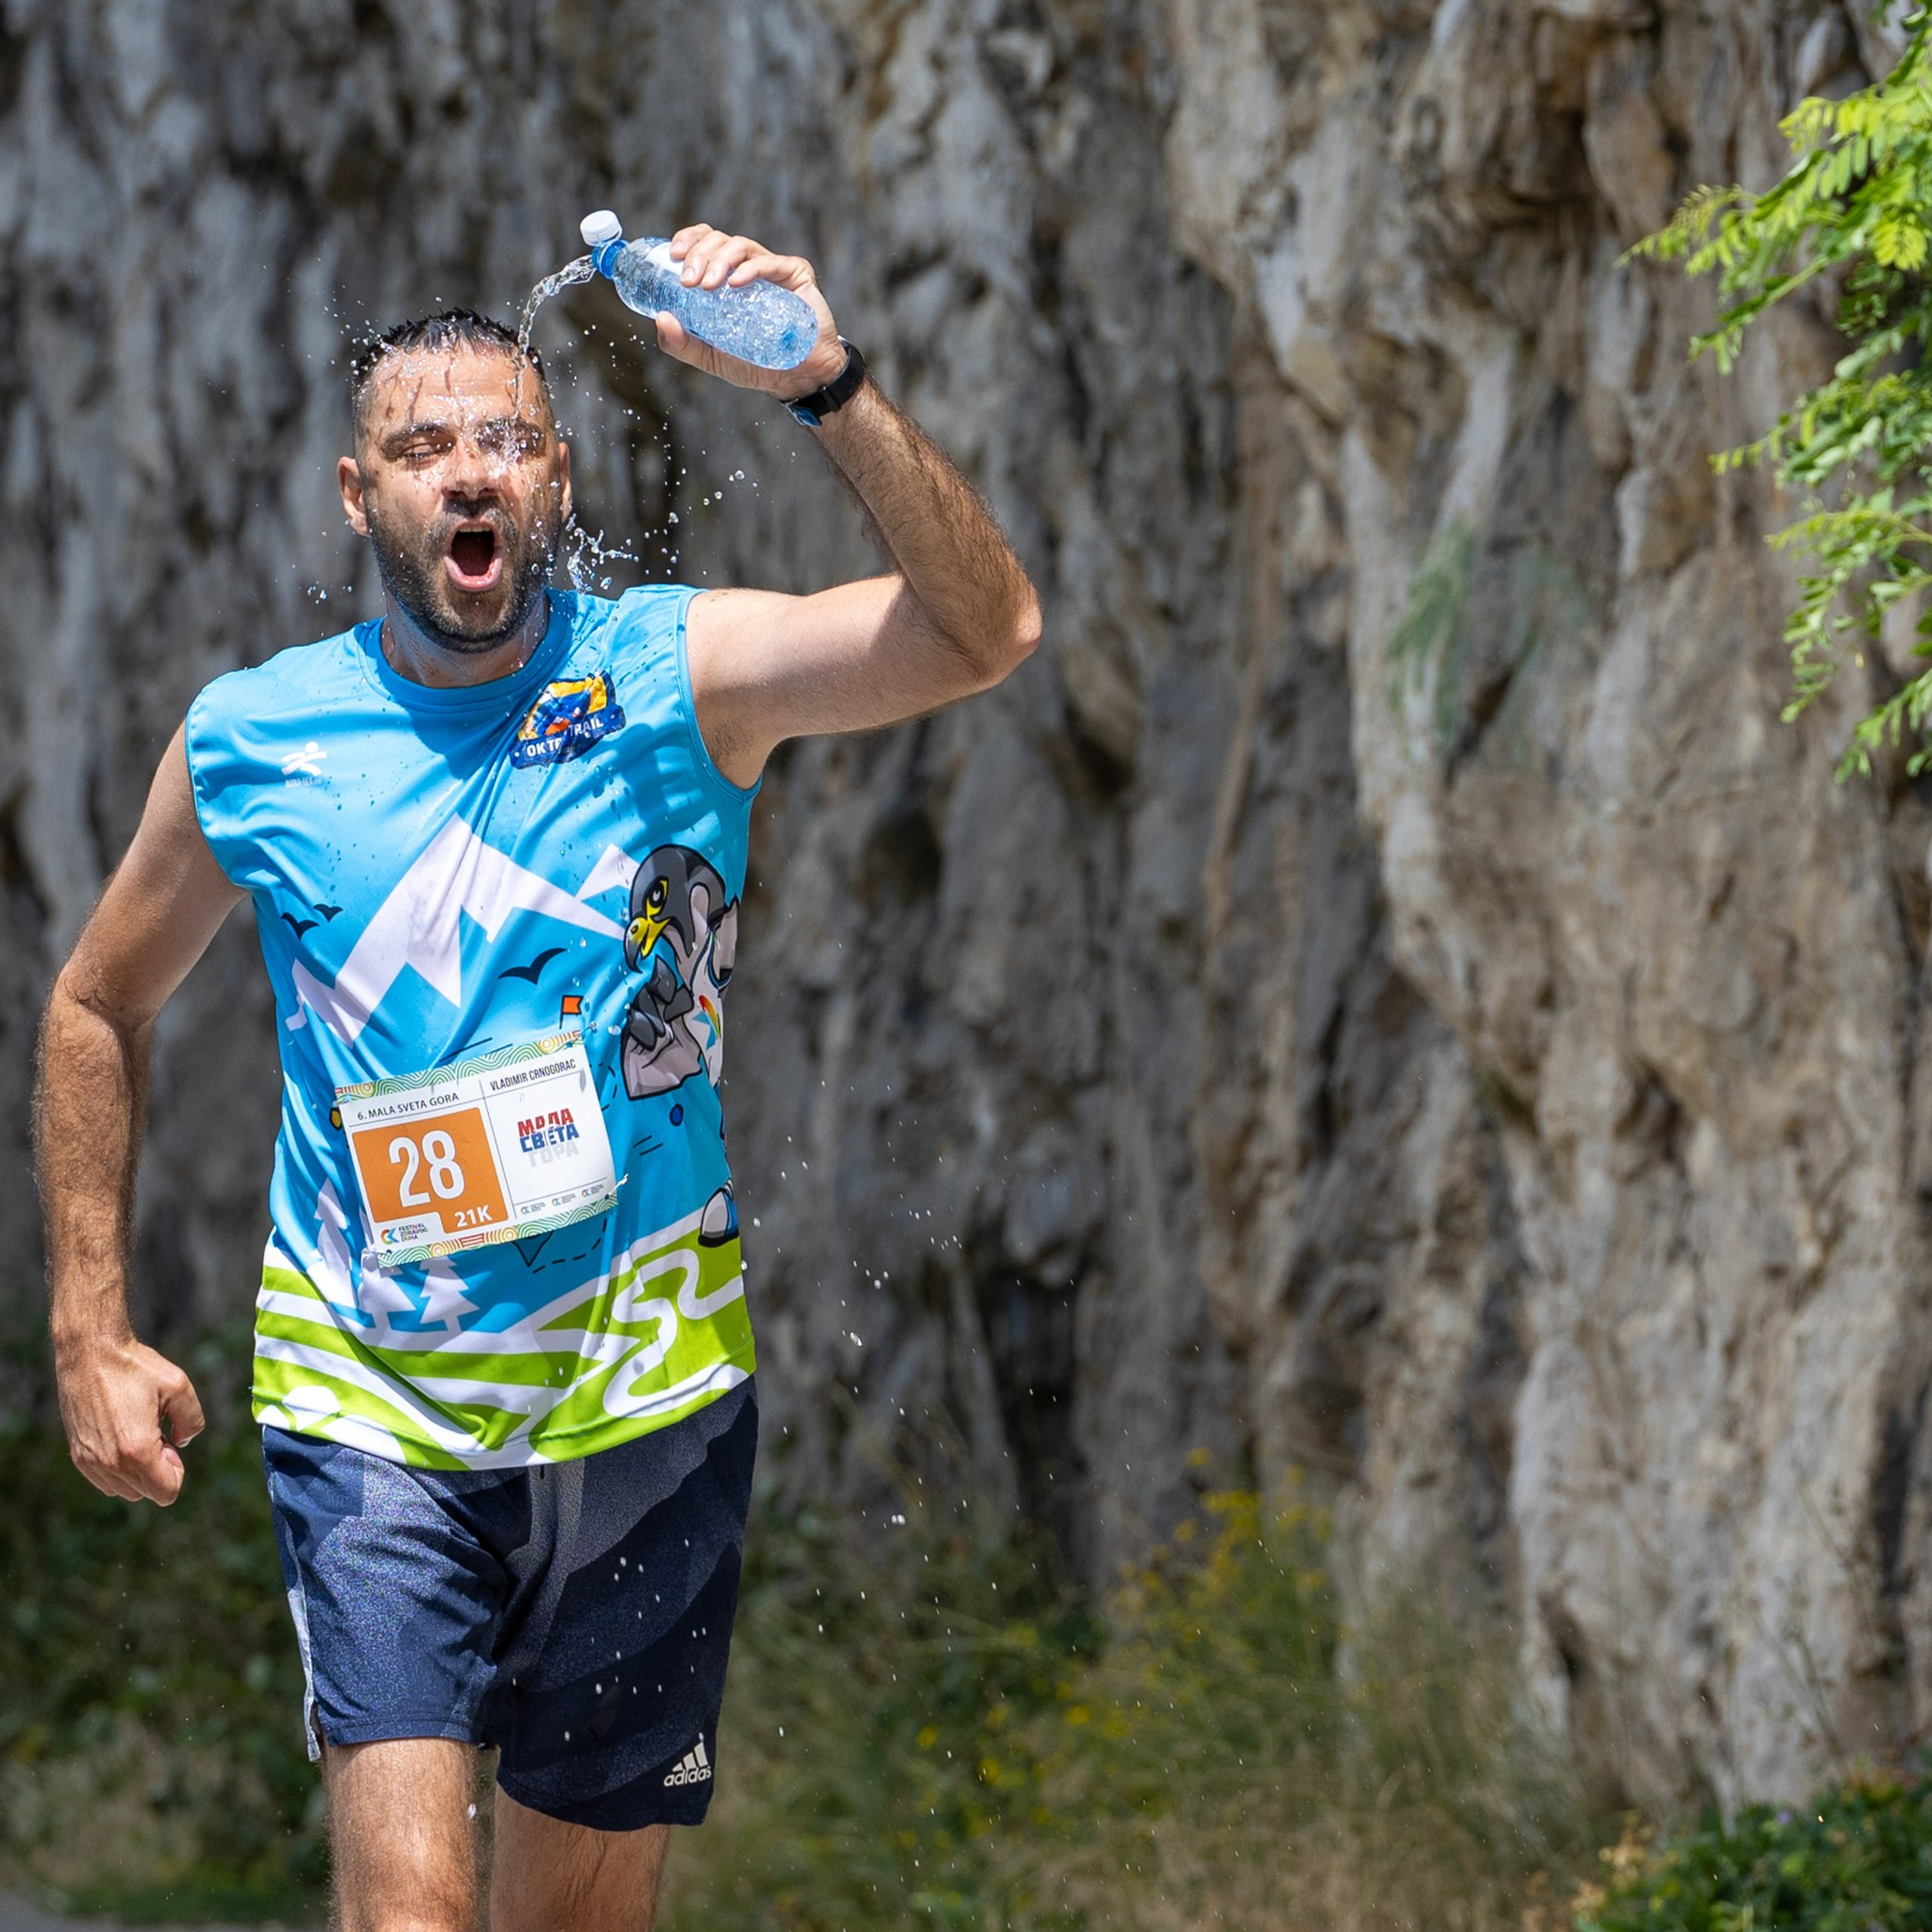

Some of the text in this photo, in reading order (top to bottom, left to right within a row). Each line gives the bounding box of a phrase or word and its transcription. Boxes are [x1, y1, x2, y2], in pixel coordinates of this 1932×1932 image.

[526, 741, 547, 758] OK
[568, 718, 604, 737] TRAIL
[490, 1059, 577, 1091] VLADIMIR CRNOGORAC
[357, 1092, 460, 1121] 6. MALA SVETA GORA
[389, 1130, 466, 1208] 28
[398, 1222, 425, 1232] FESTIVAL
[454, 1204, 493, 1229] 21K
[663, 1765, 712, 1787] adidas
